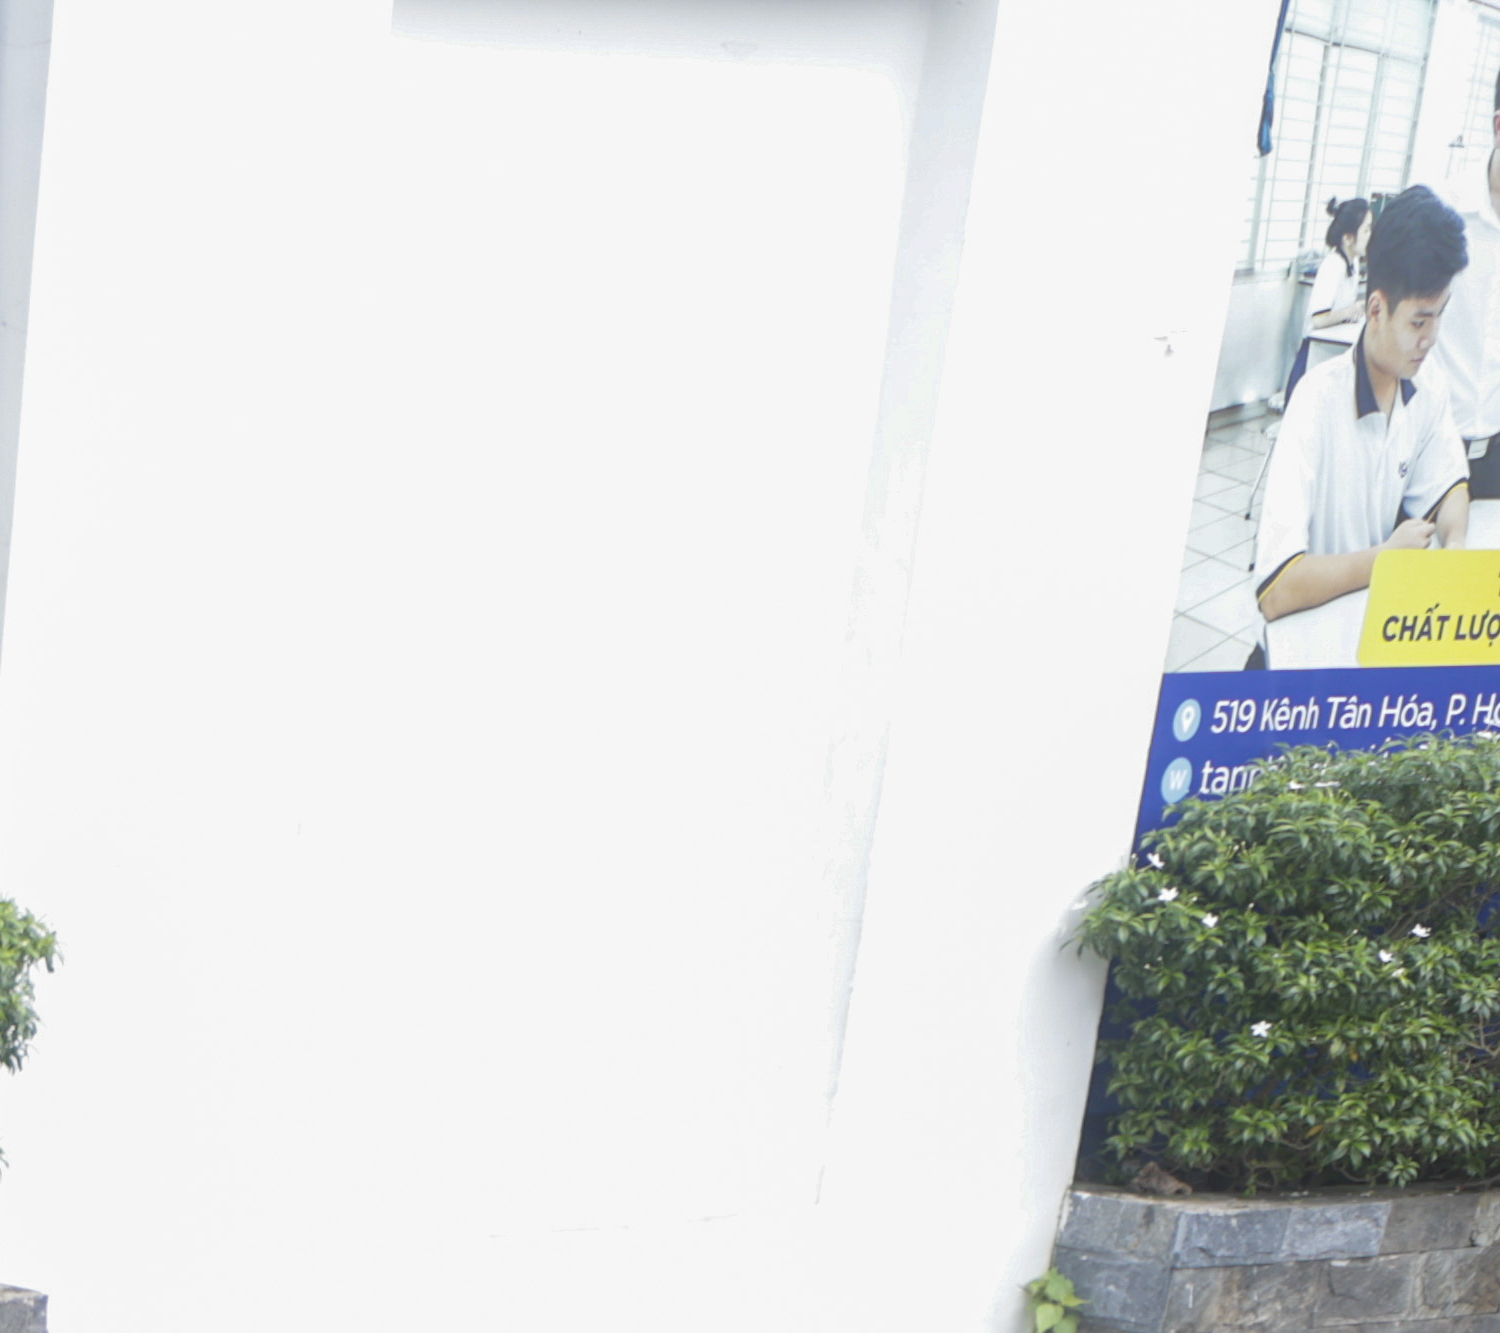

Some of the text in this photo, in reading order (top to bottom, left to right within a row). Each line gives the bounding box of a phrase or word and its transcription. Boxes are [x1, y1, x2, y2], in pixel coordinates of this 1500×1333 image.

[1382, 602, 1450, 642] CHẤT
[1210, 699, 1256, 734] 519
[1260, 696, 1320, 731] Kênh
[1326, 695, 1372, 729] Tân
[1378, 694, 1438, 731] Hóa,
[1445, 693, 1467, 726] P.
